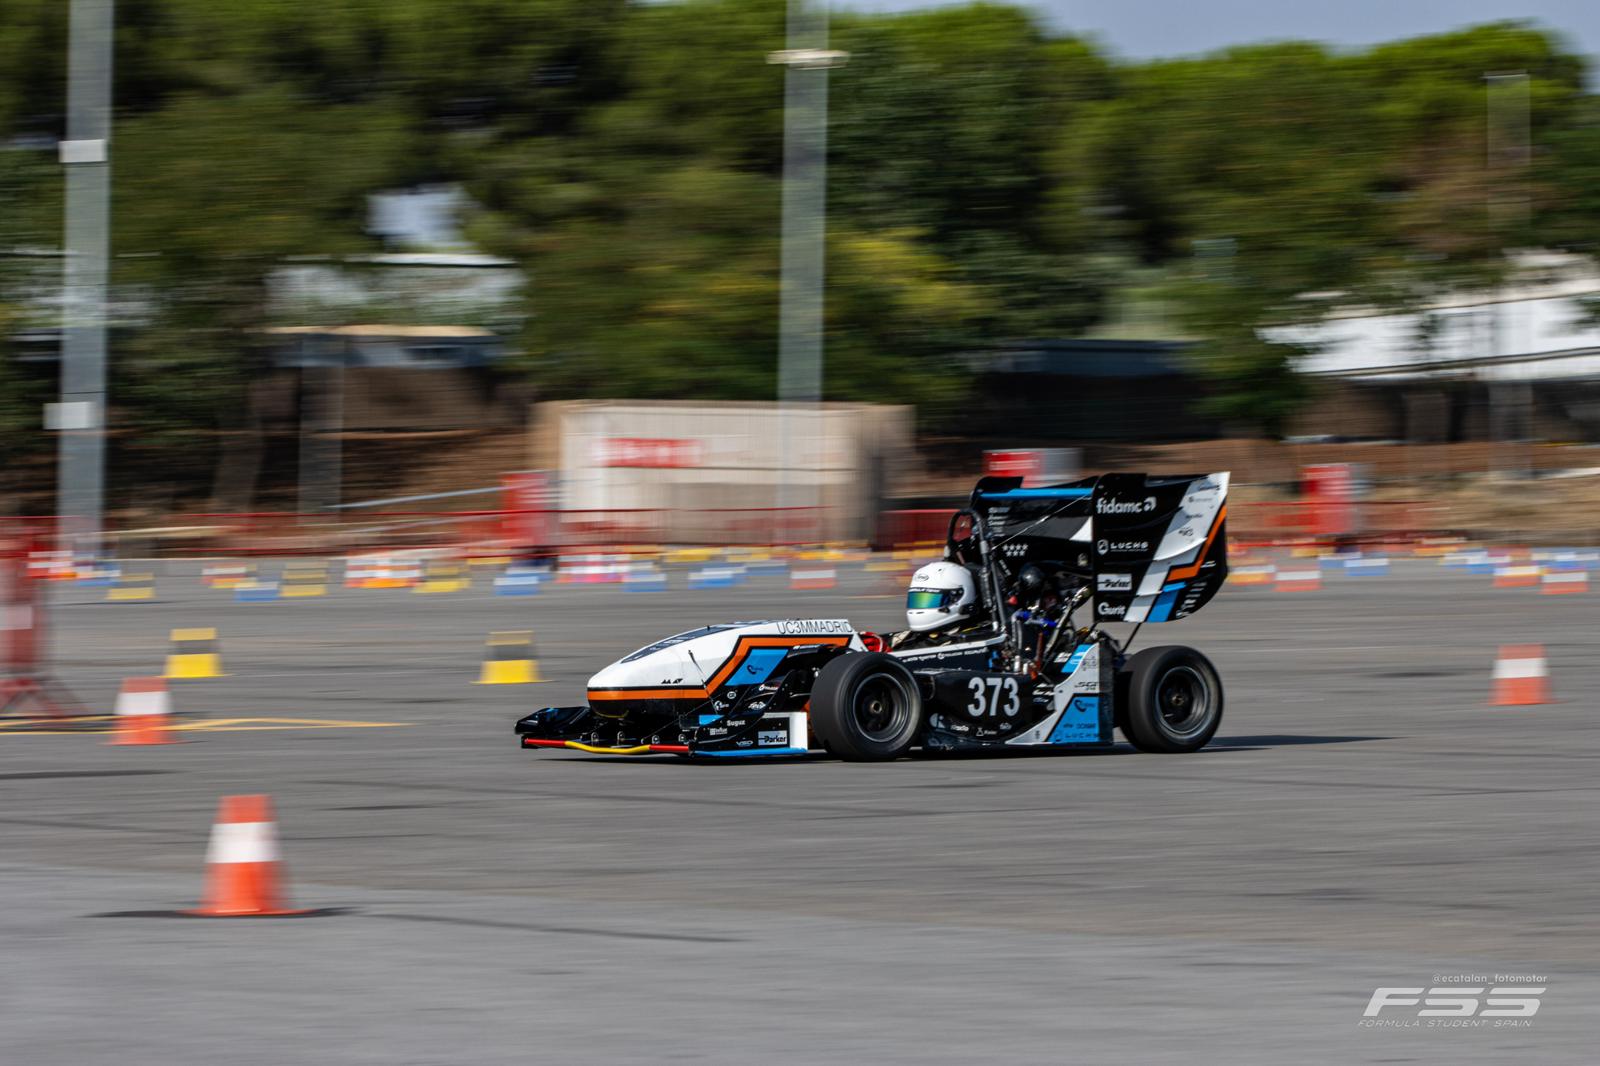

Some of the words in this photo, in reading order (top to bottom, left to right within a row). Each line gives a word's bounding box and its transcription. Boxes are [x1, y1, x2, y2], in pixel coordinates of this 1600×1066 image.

[1096, 497, 1143, 514] fidamc
[1110, 541, 1149, 549] LUCHS
[1103, 578, 1131, 588] Parker
[1098, 602, 1126, 616] Gurit
[776, 620, 854, 634] UC3MMADRID
[967, 676, 1021, 717] 373
[764, 735, 787, 744] Parker
